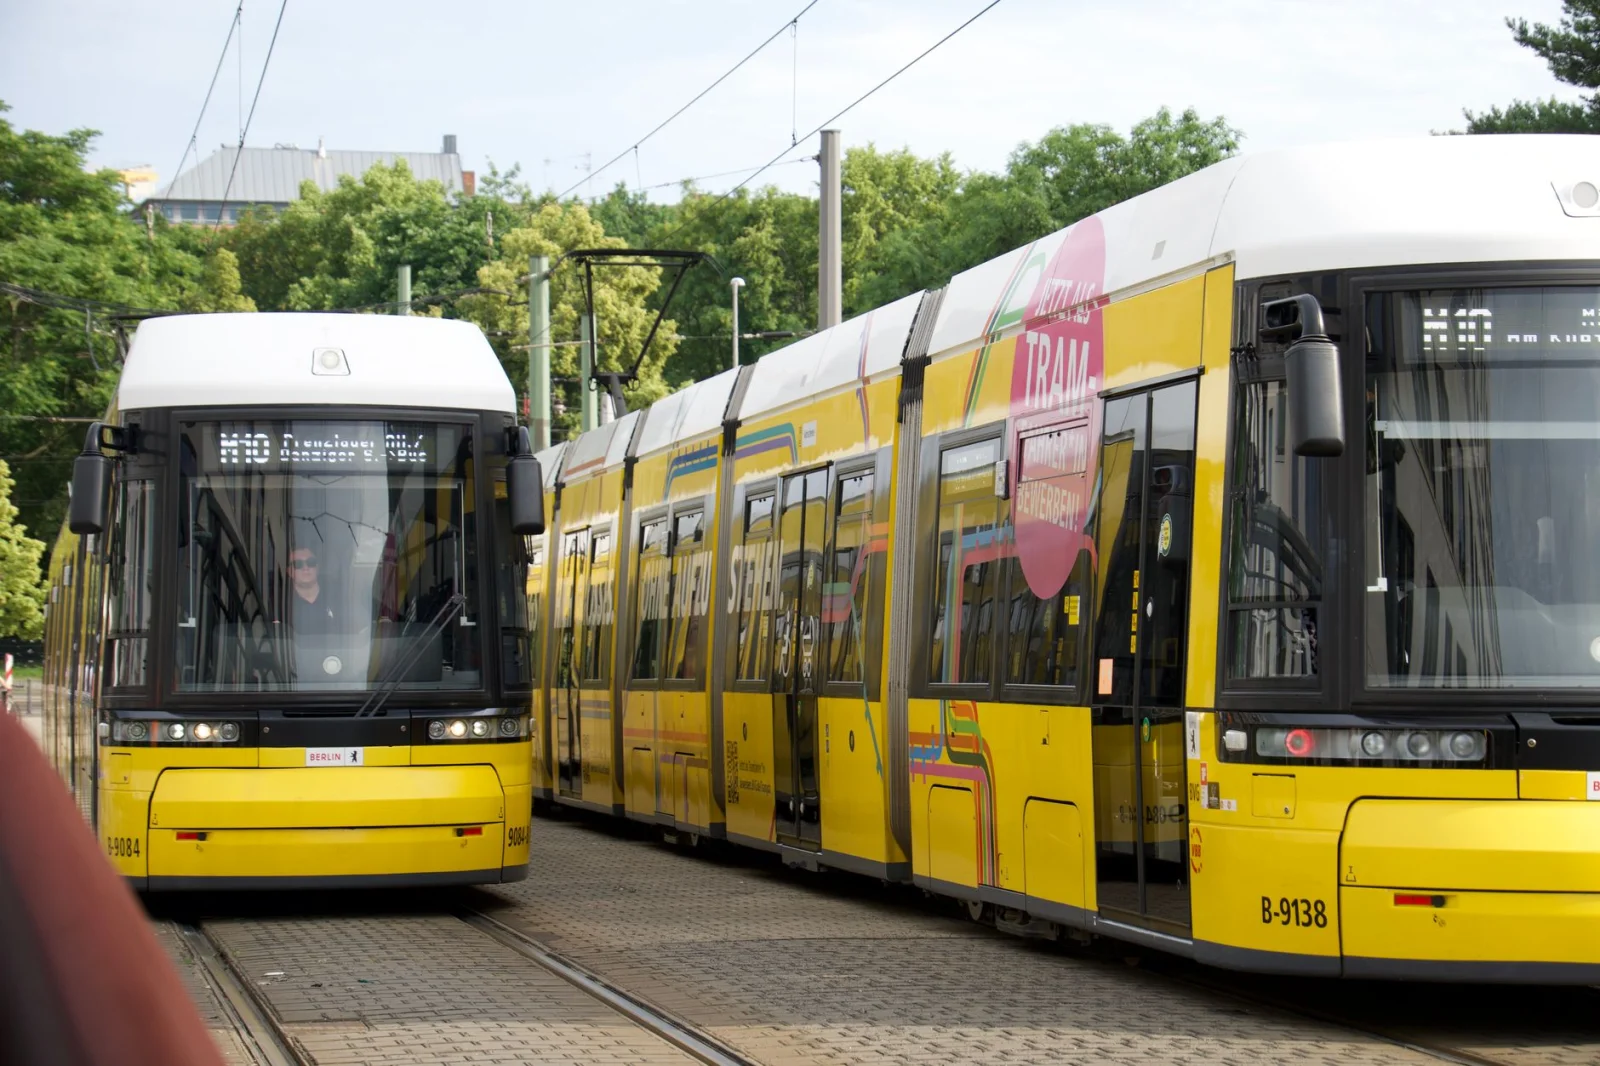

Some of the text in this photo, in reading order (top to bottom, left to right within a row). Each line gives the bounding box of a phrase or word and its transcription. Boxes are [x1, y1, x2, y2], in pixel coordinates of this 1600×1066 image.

[1035, 277, 1073, 321] JETZT
[1025, 331, 1097, 416] TRAM-
[221, 433, 269, 463] M10
[1016, 475, 1080, 532] BEWERBEN!
[309, 752, 341, 762] BERLIN
[1261, 895, 1328, 929] B-9138
